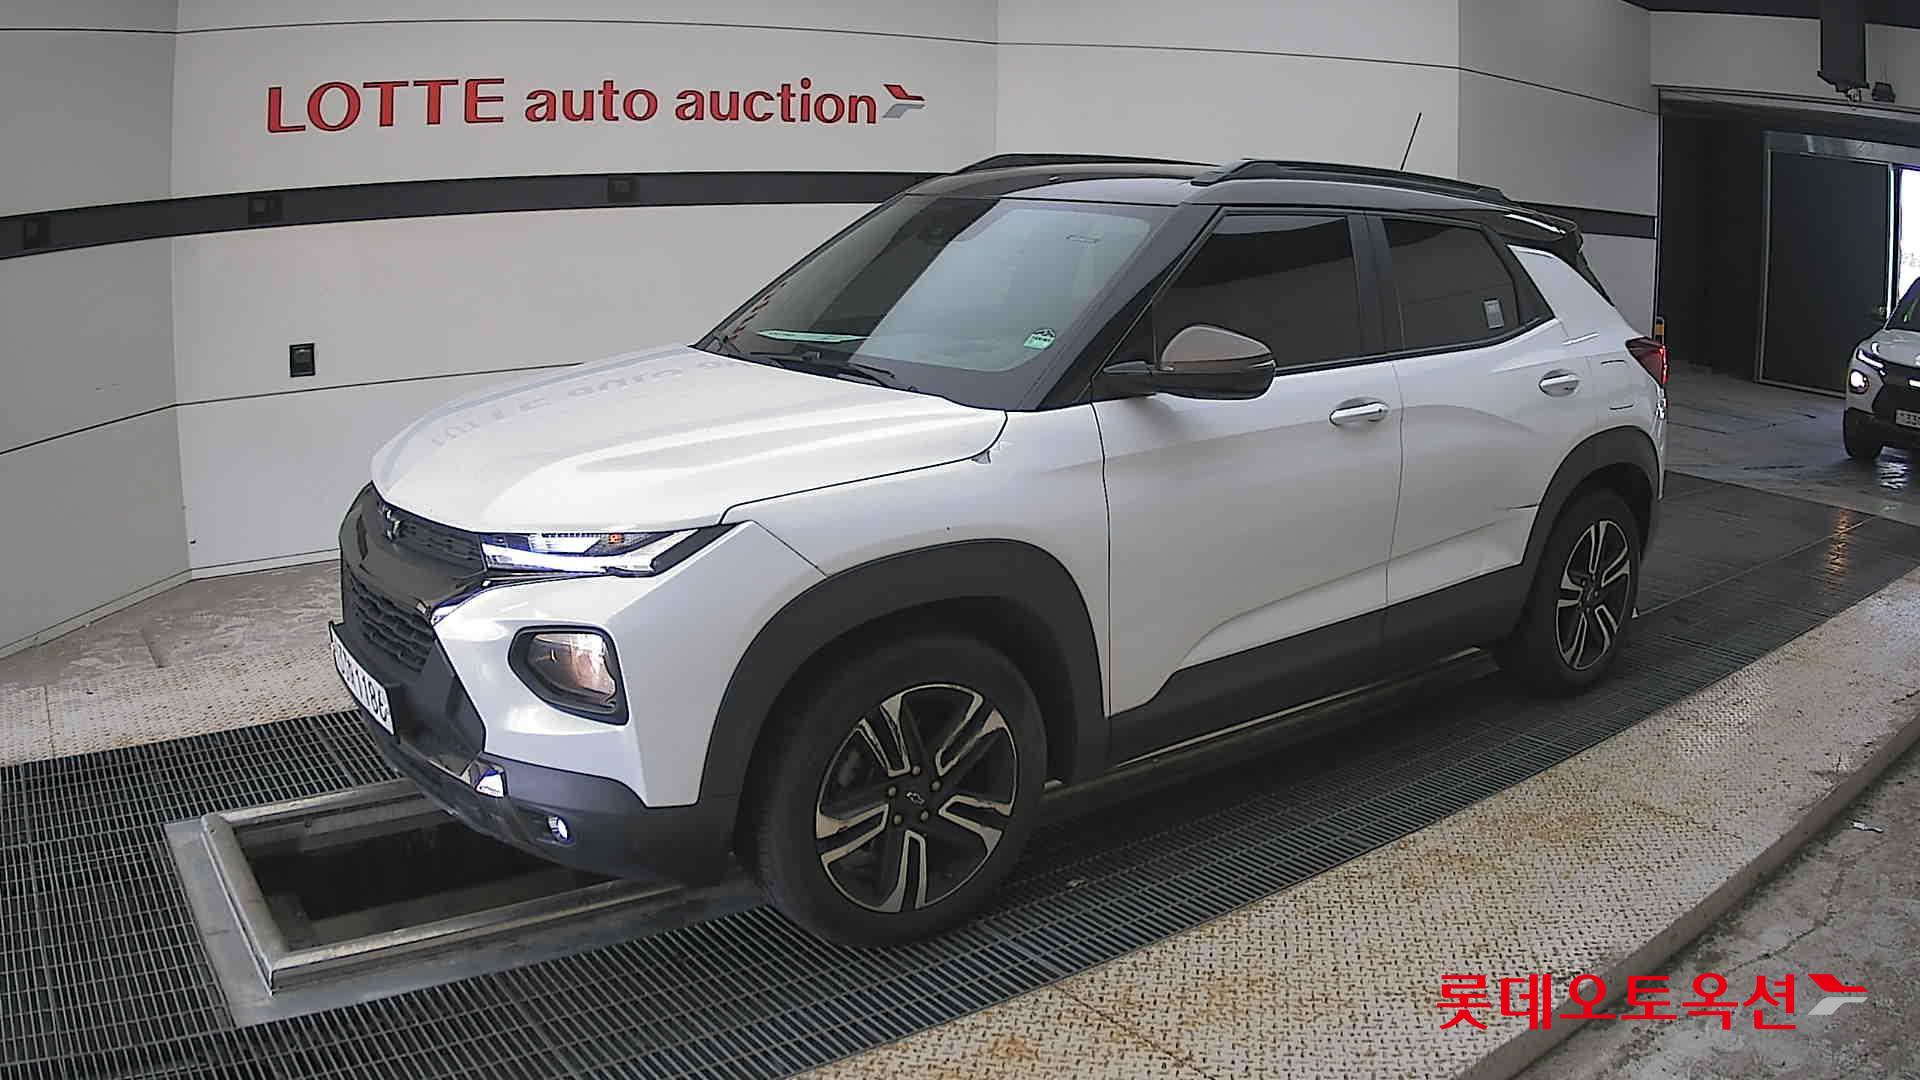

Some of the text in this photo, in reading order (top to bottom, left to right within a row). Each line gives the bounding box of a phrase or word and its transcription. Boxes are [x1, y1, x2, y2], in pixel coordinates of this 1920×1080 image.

[266, 77, 877, 134] LOTTE auto auction
